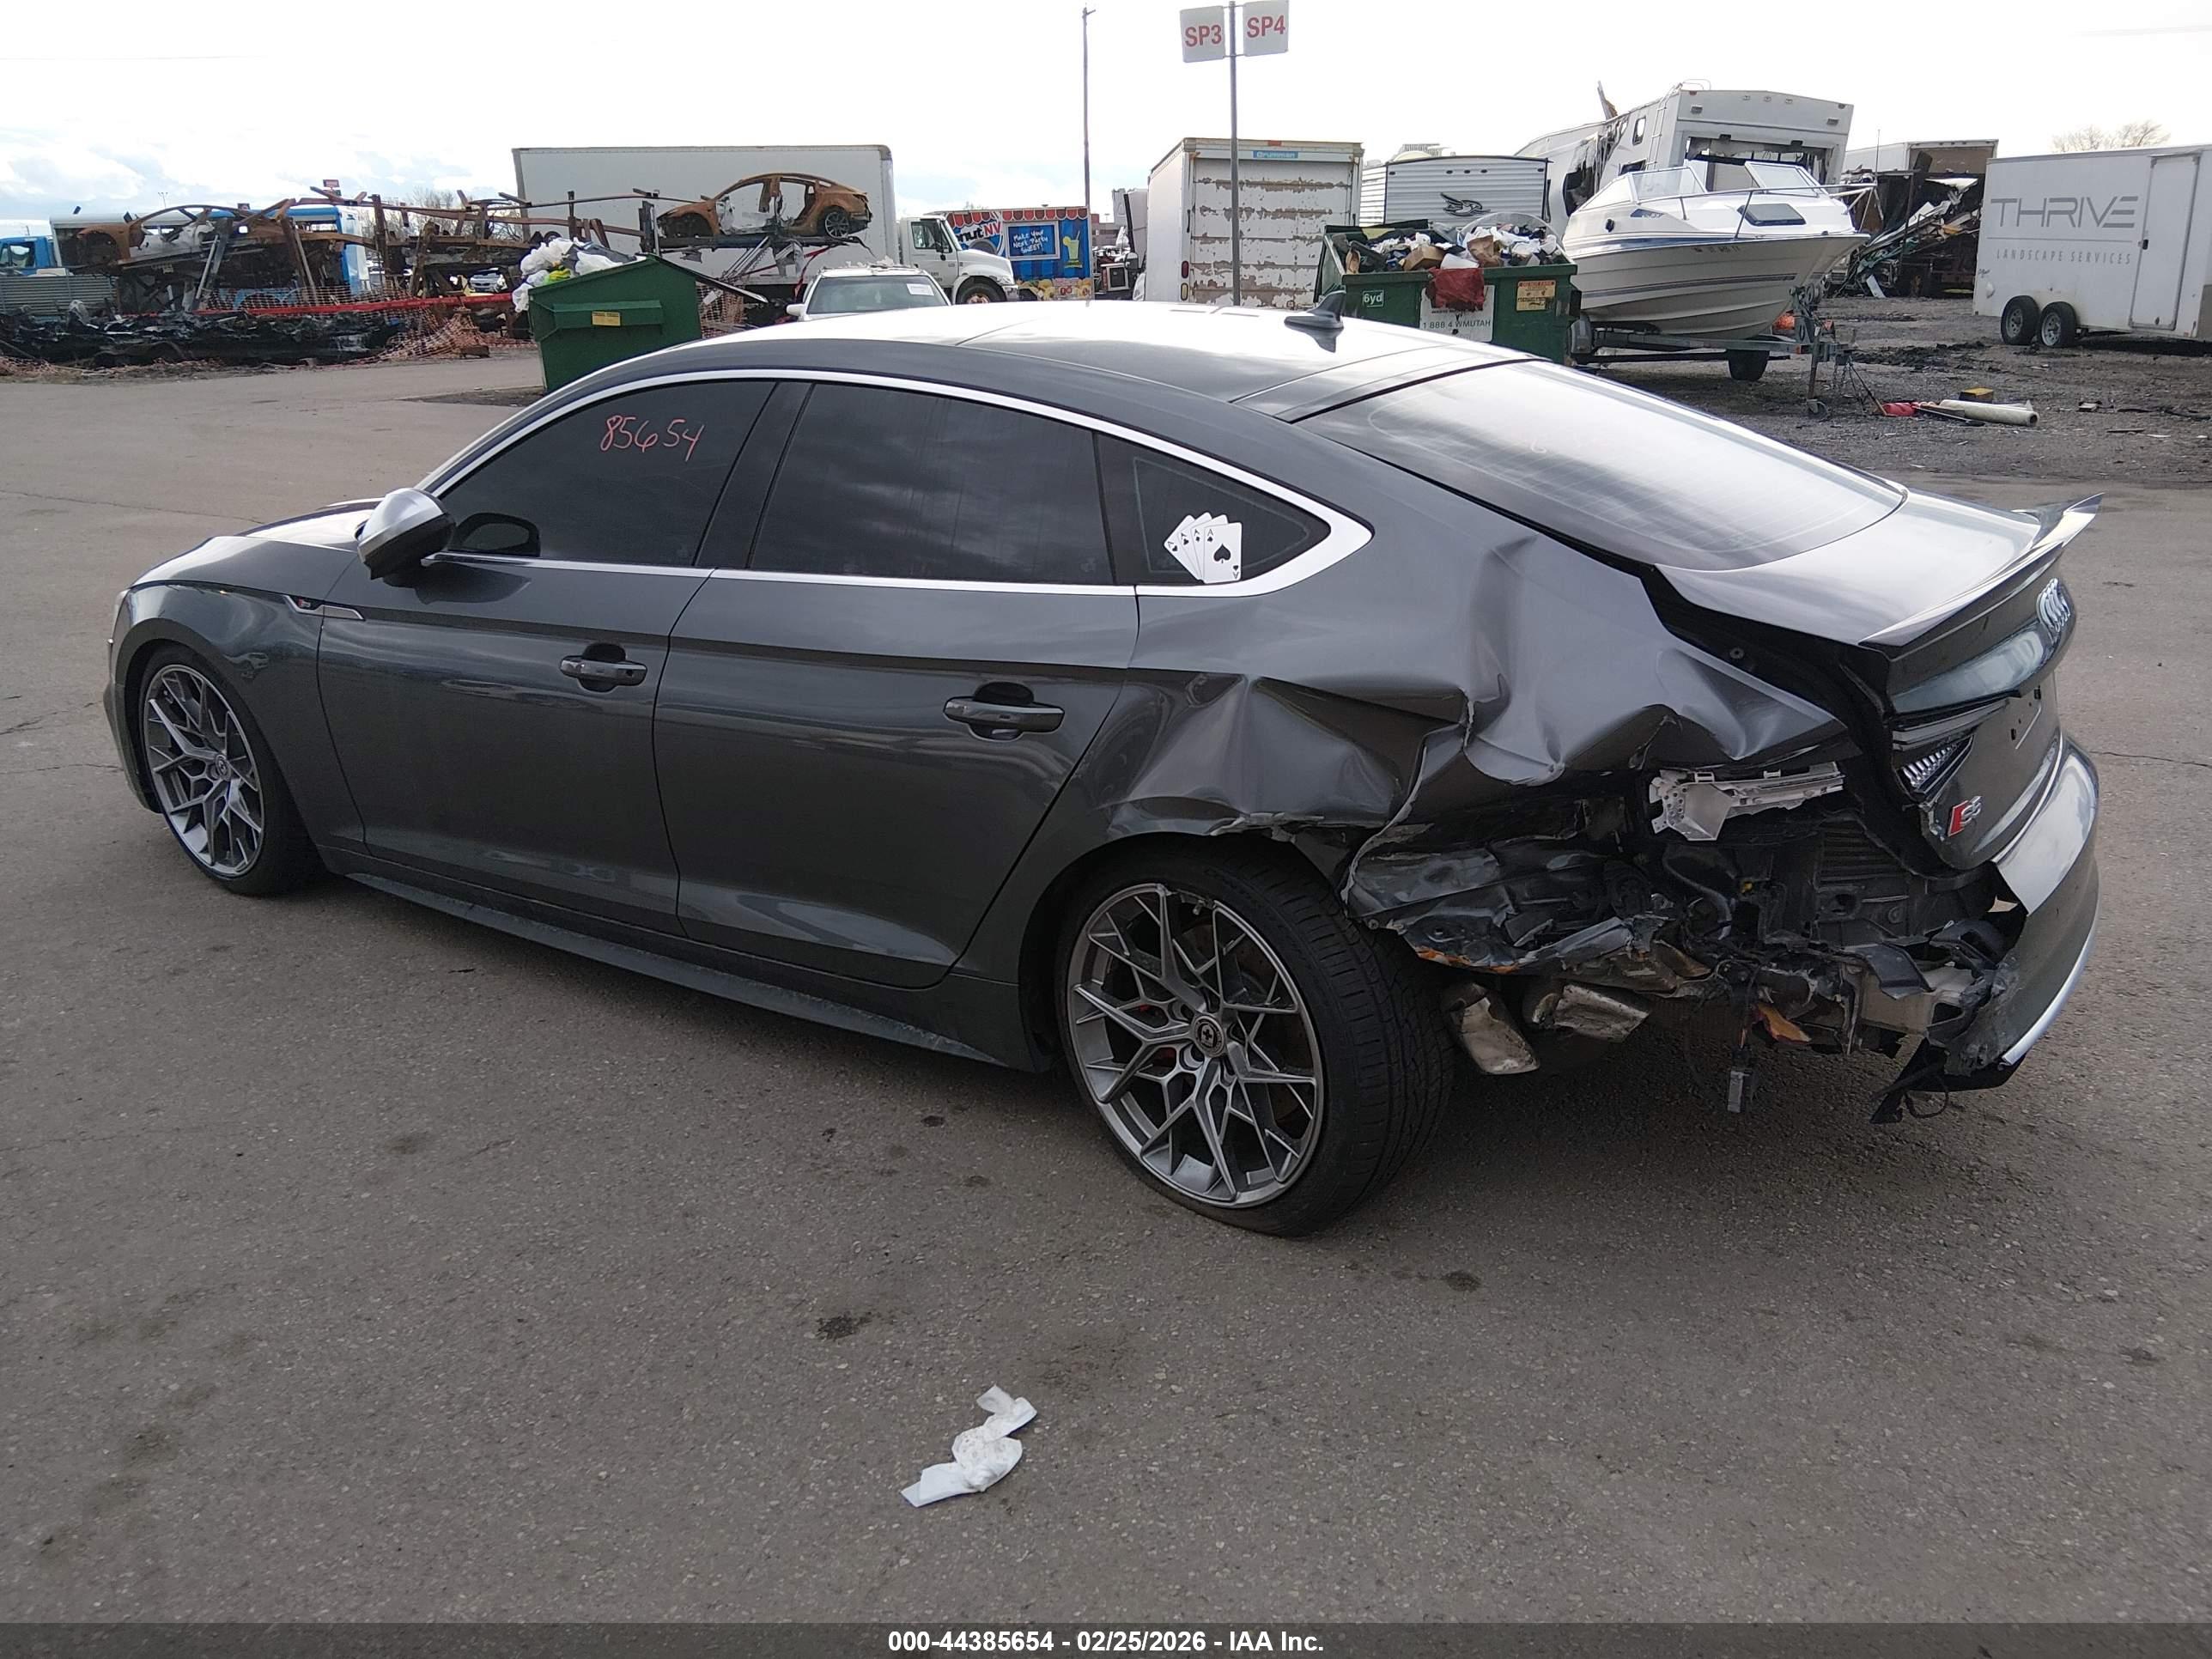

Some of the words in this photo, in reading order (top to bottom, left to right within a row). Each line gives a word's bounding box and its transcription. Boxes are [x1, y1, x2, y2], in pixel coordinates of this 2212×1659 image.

[1185, 24, 1222, 47] SP3
[1247, 15, 1285, 38] SP4
[1990, 196, 2139, 228] THRIVE
[1996, 248, 2063, 262] LANDSCAPE
[2070, 251, 2131, 265] SERVICES
[1364, 293, 1383, 305] 6yd
[1455, 319, 1491, 328] WMUTAH
[600, 415, 705, 462] 85654
